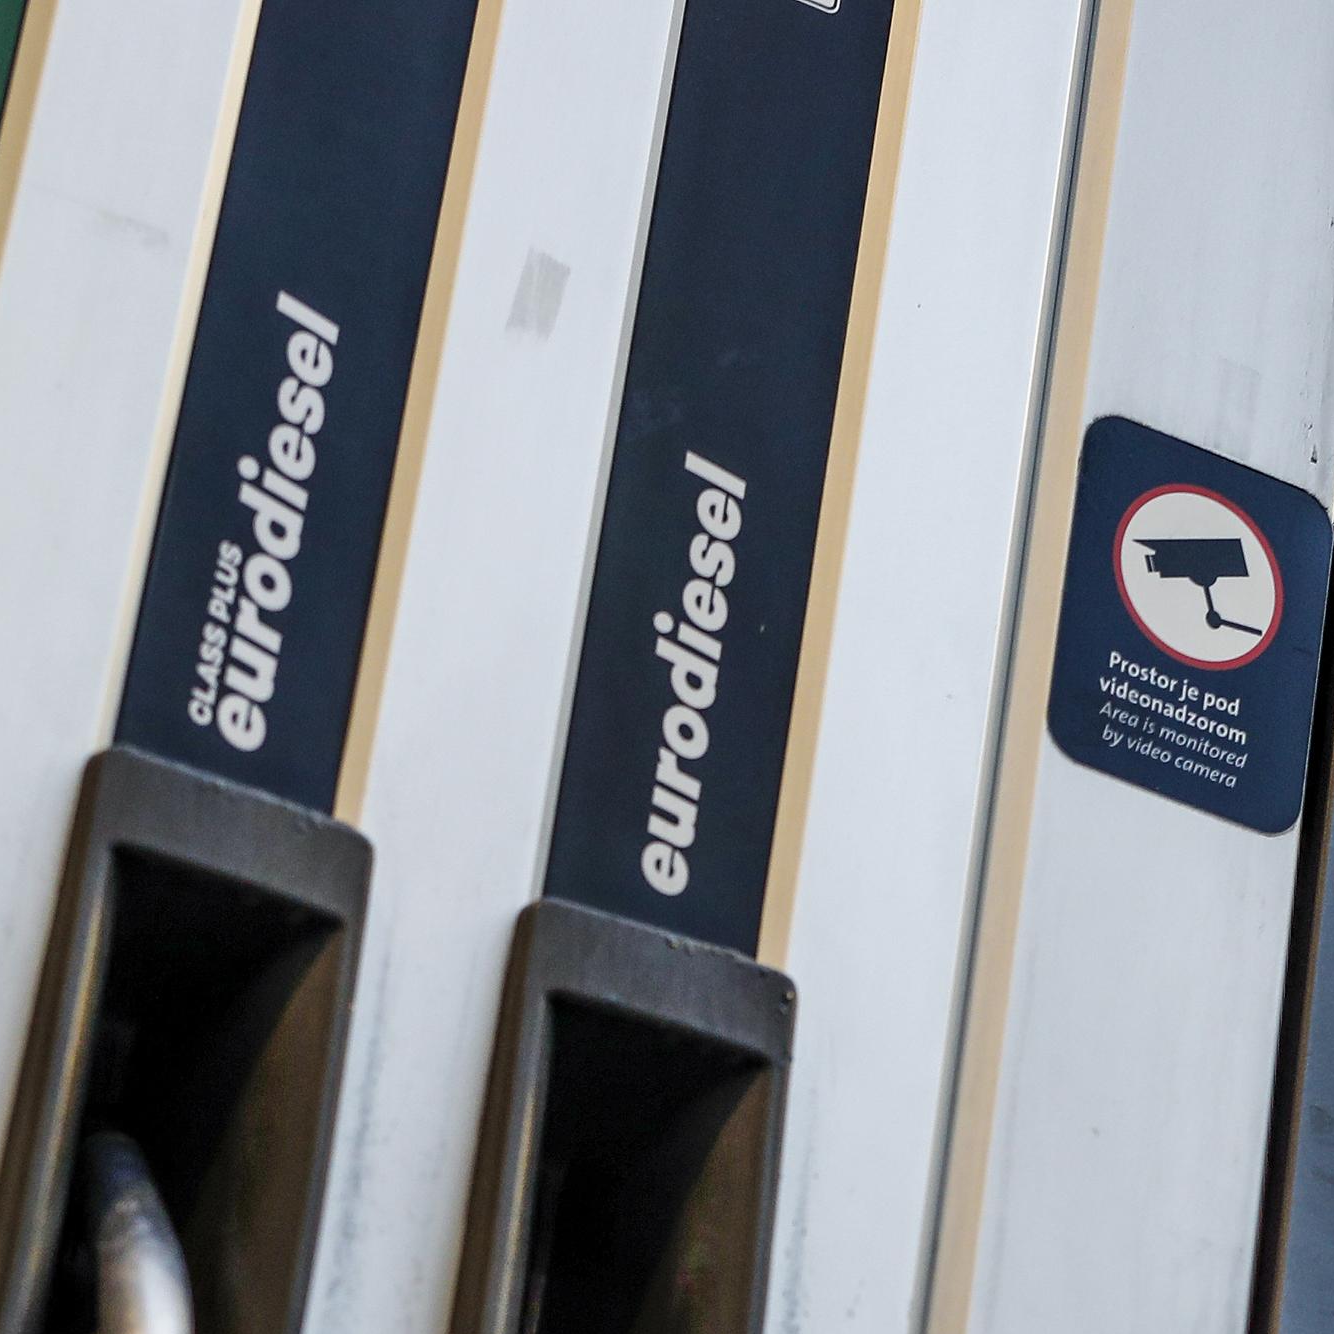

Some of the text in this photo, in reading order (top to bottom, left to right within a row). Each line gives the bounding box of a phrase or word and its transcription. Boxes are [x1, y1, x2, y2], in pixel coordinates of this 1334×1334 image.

[217, 290, 340, 752] eurodiesel
[188, 539, 243, 727] CLASS PLUS
[641, 451, 746, 896] eurodiesel
[1109, 651, 1240, 717] Prostor je pod
[1099, 676, 1246, 745] videonadzorom
[1099, 701, 1248, 769] Area is monitored
[1102, 724, 1237, 789] by video camera
